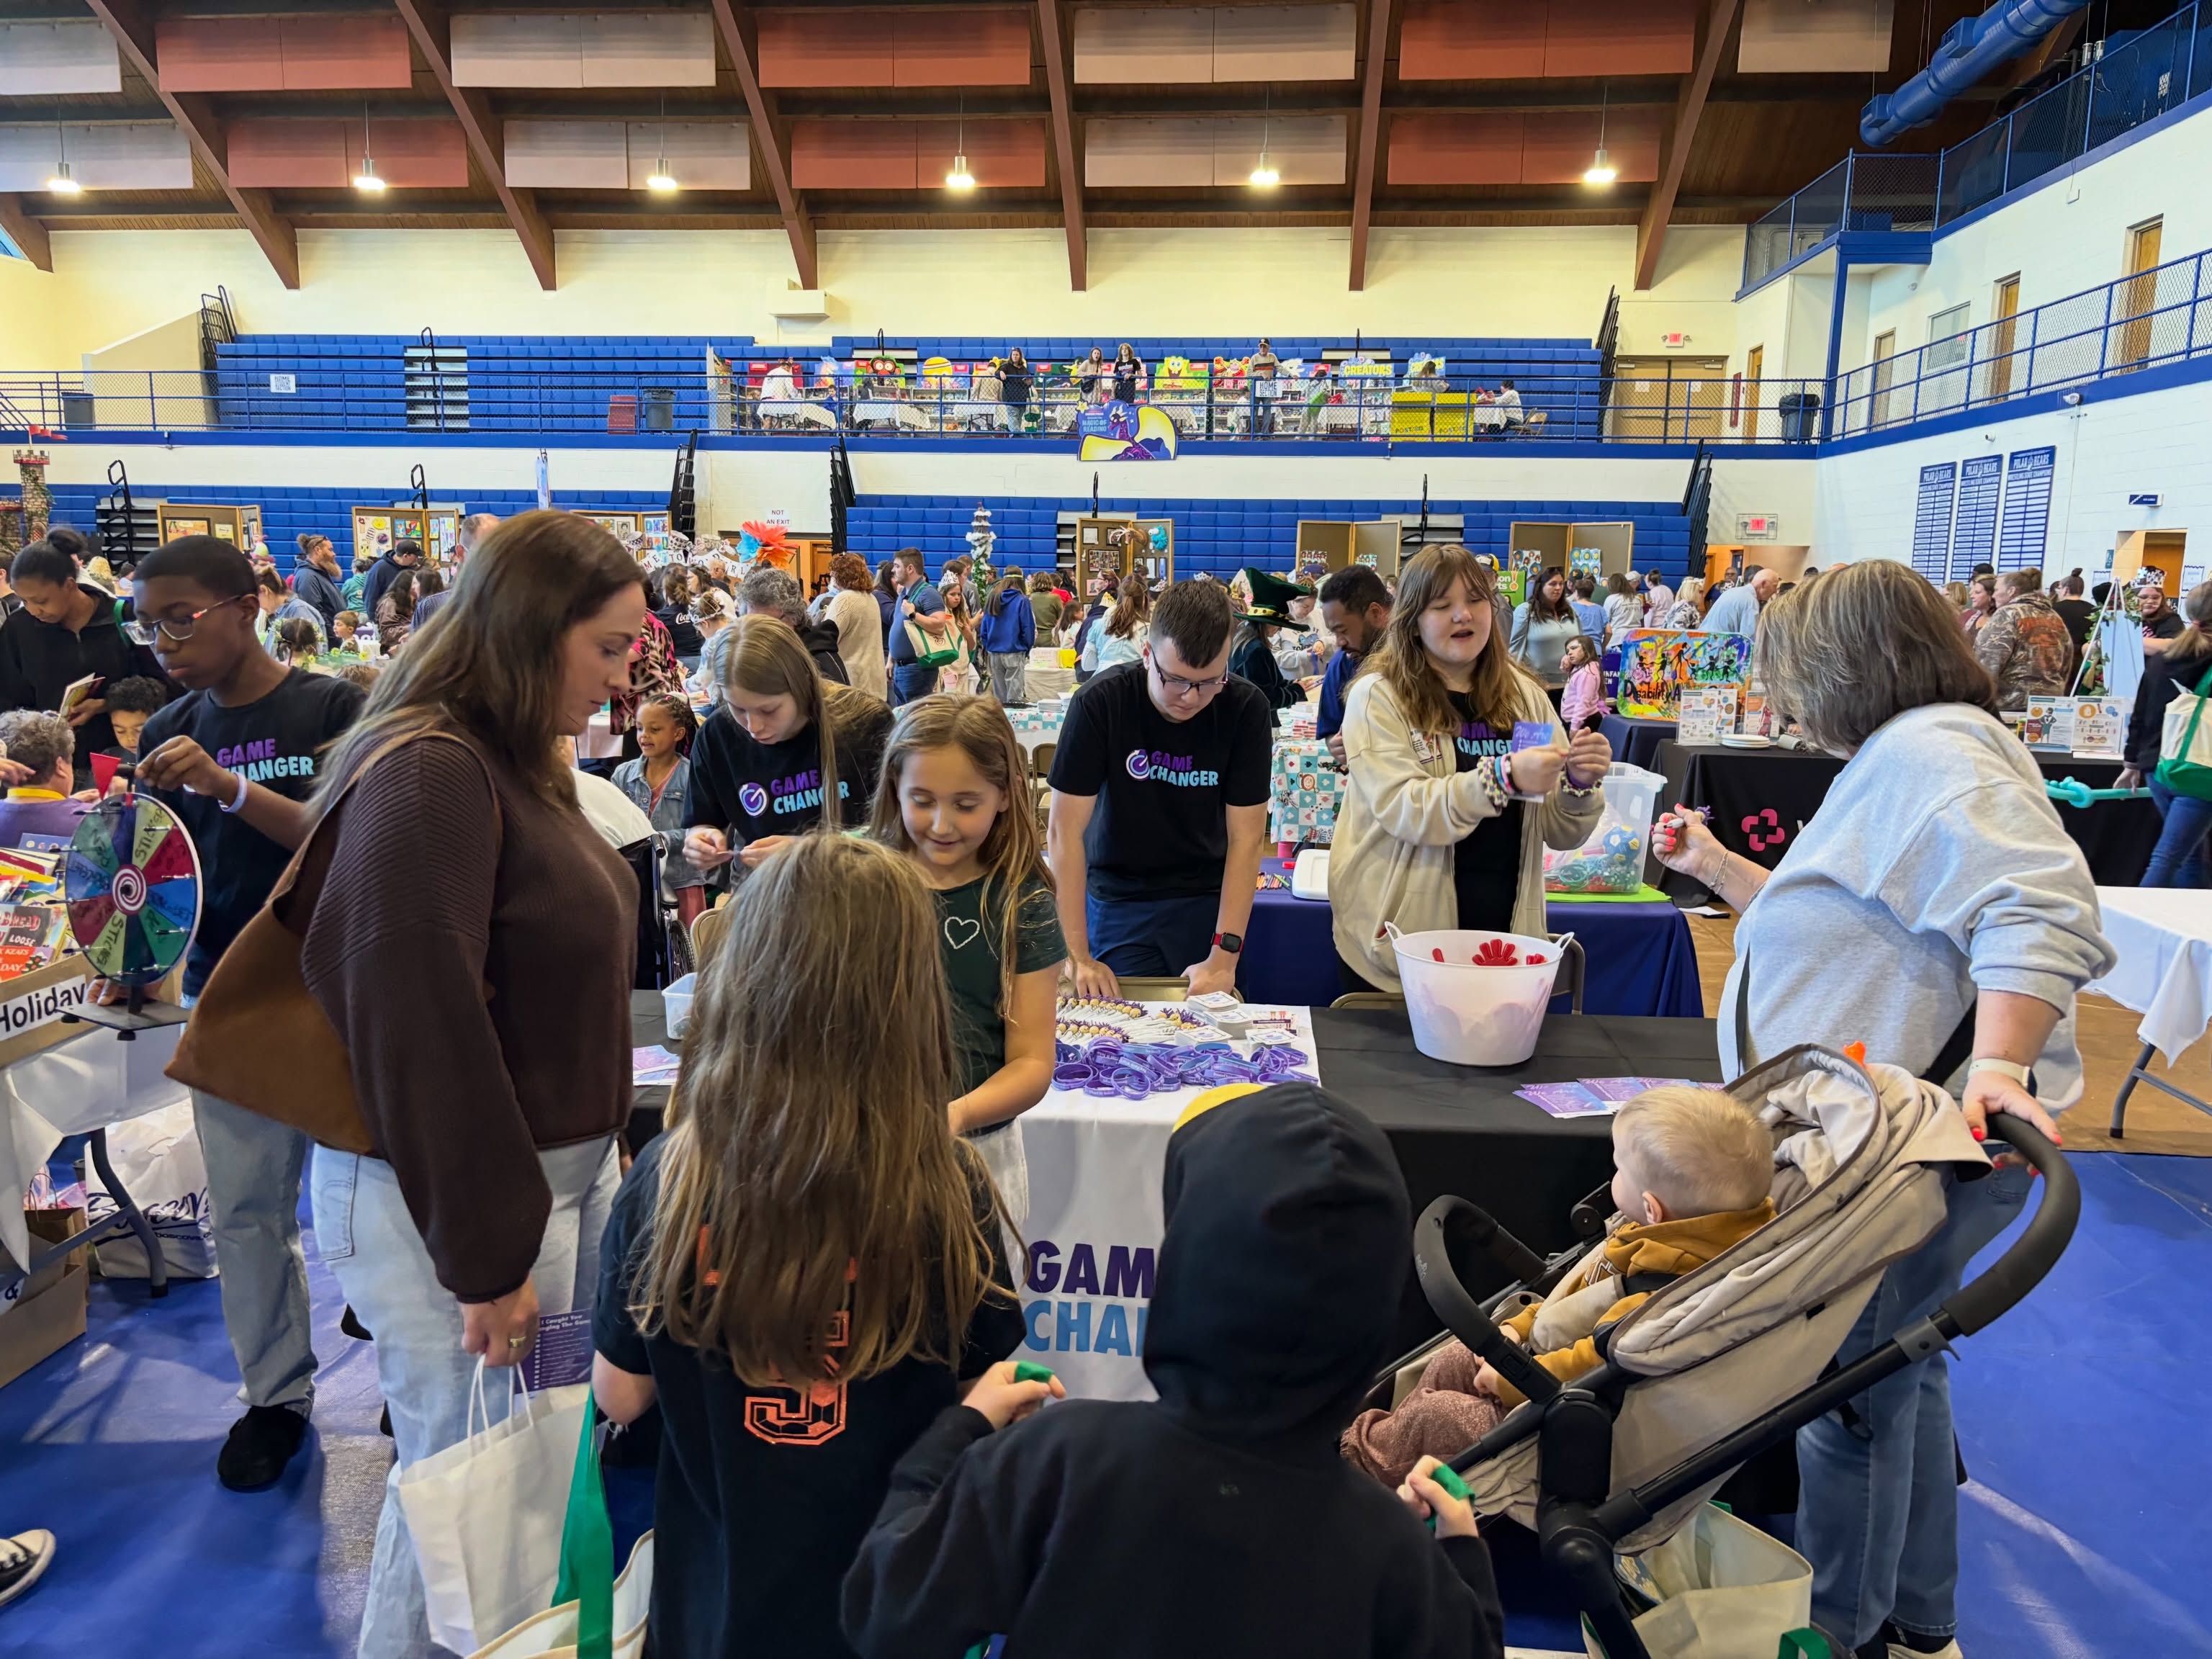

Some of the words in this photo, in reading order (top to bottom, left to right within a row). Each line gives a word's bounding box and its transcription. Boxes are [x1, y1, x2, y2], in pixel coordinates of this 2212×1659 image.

[1344, 364, 1393, 375] CREATORS
[2013, 457, 2028, 469] POLAR
[2033, 454, 2049, 467] BEARS
[668, 553, 683, 562] TO
[1623, 678, 1672, 705] Disability
[217, 738, 276, 767] GAME
[1151, 750, 1193, 772] GAME
[224, 756, 315, 782] HANGER
[1150, 765, 1219, 787] CHANGER
[770, 769, 820, 796] GAME
[773, 781, 850, 815] CHANR
[9, 934, 36, 947] LOOSE
[0, 963, 22, 972] DAY
[1022, 1240, 1155, 1299] GAM
